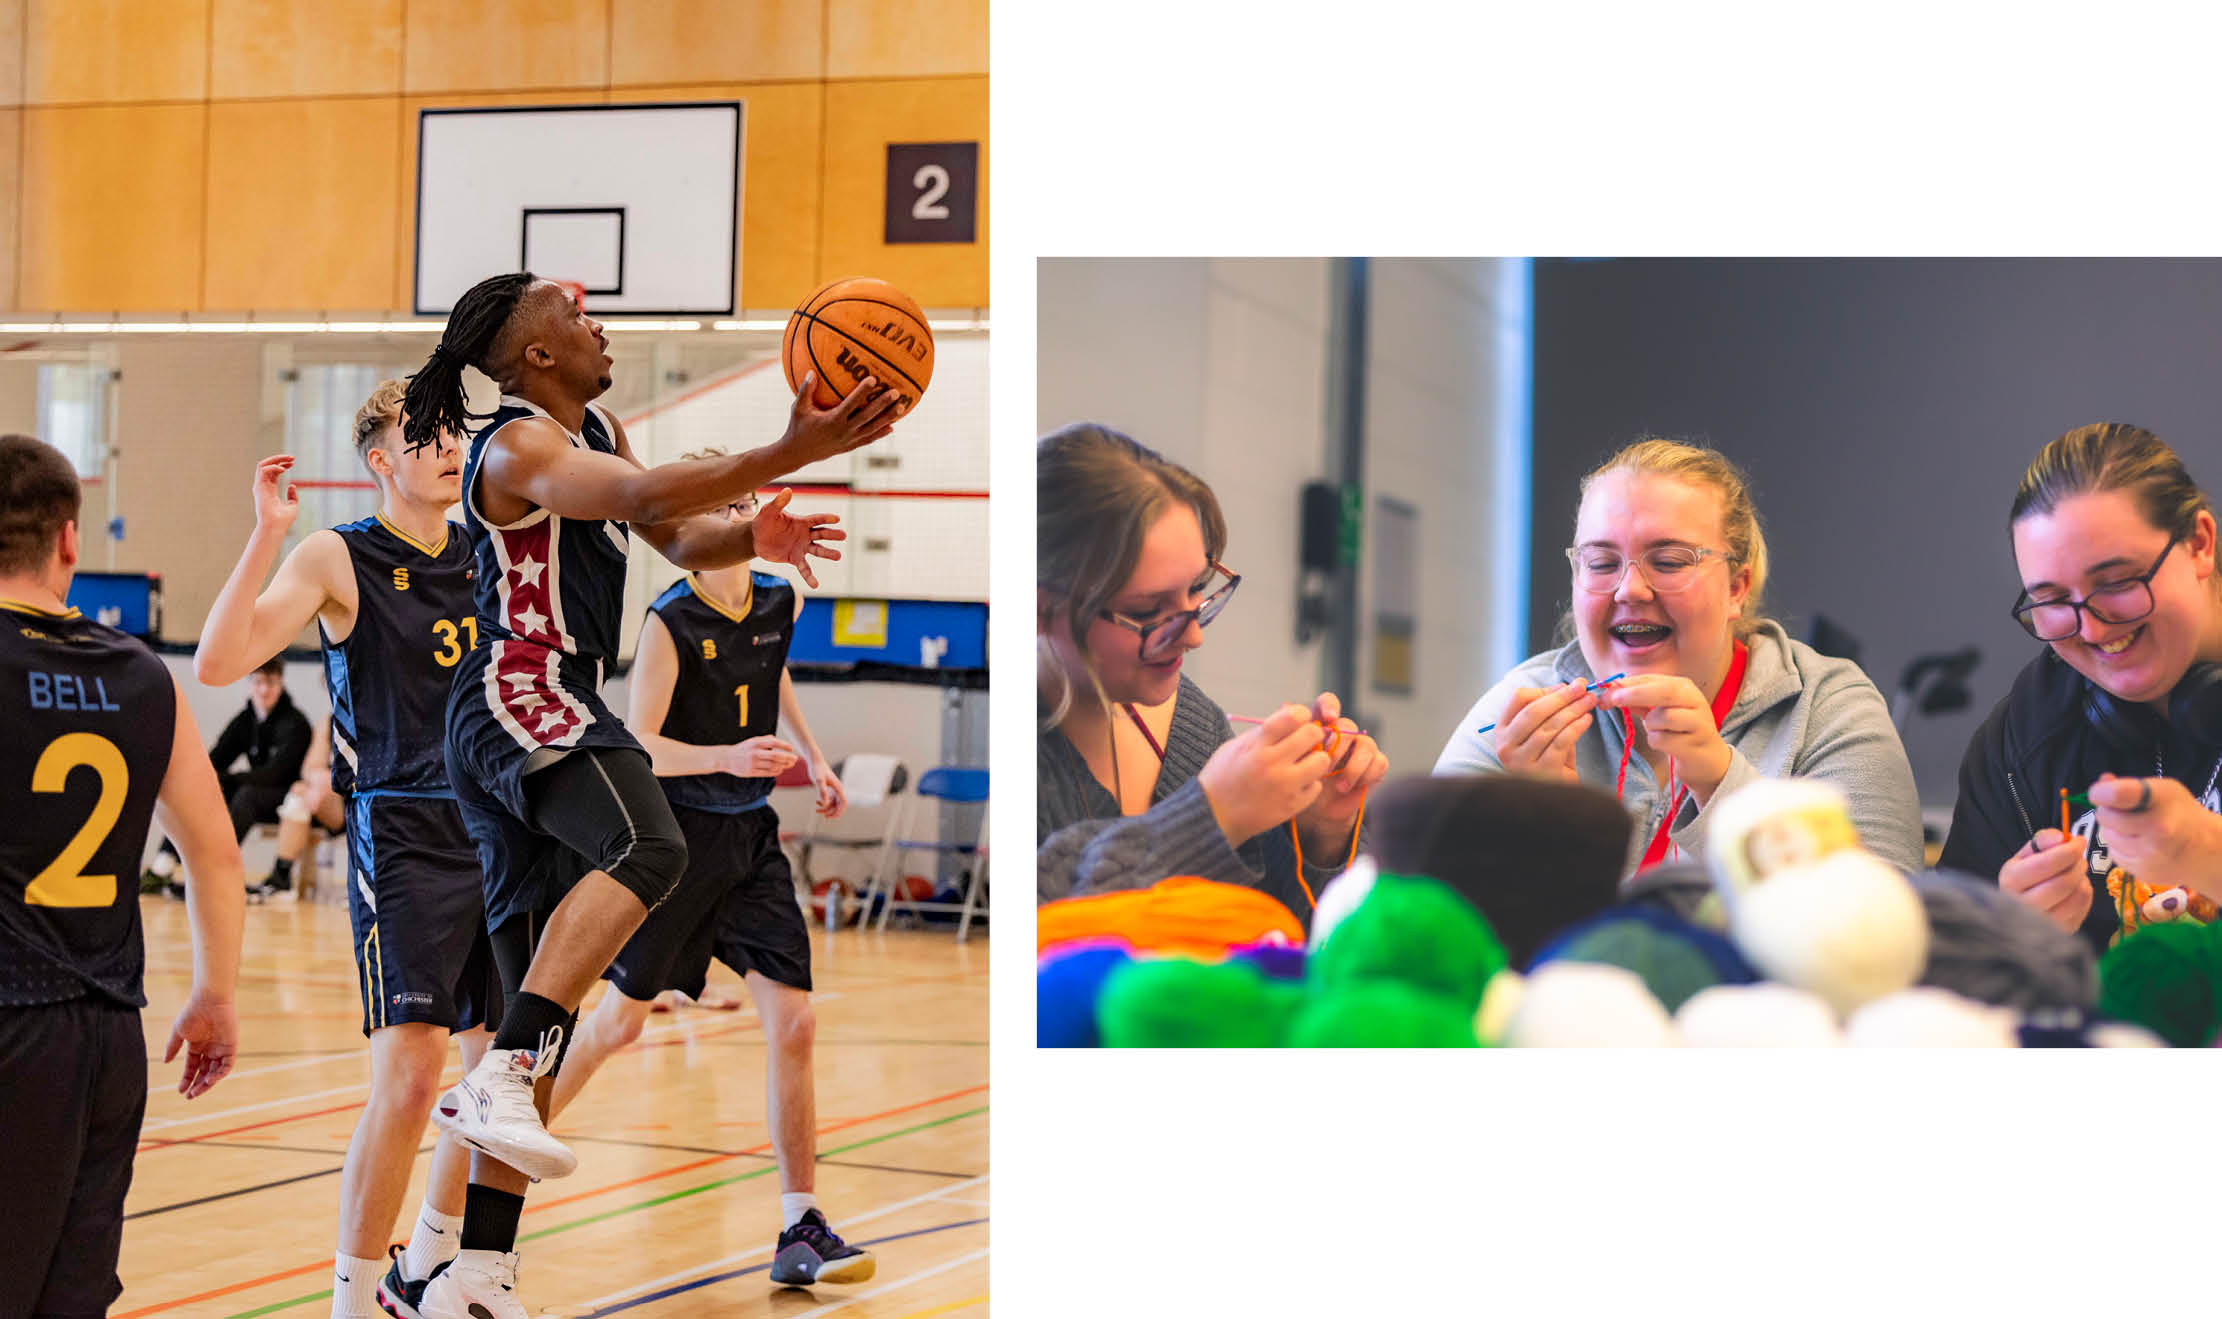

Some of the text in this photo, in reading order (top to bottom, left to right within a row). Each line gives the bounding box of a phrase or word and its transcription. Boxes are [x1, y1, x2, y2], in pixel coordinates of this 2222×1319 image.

[912, 164, 950, 219] 2
[880, 321, 927, 362] EVO
[432, 617, 479, 667] 31
[29, 672, 120, 711] BELL
[734, 684, 749, 728] 1
[24, 732, 129, 908] 2
